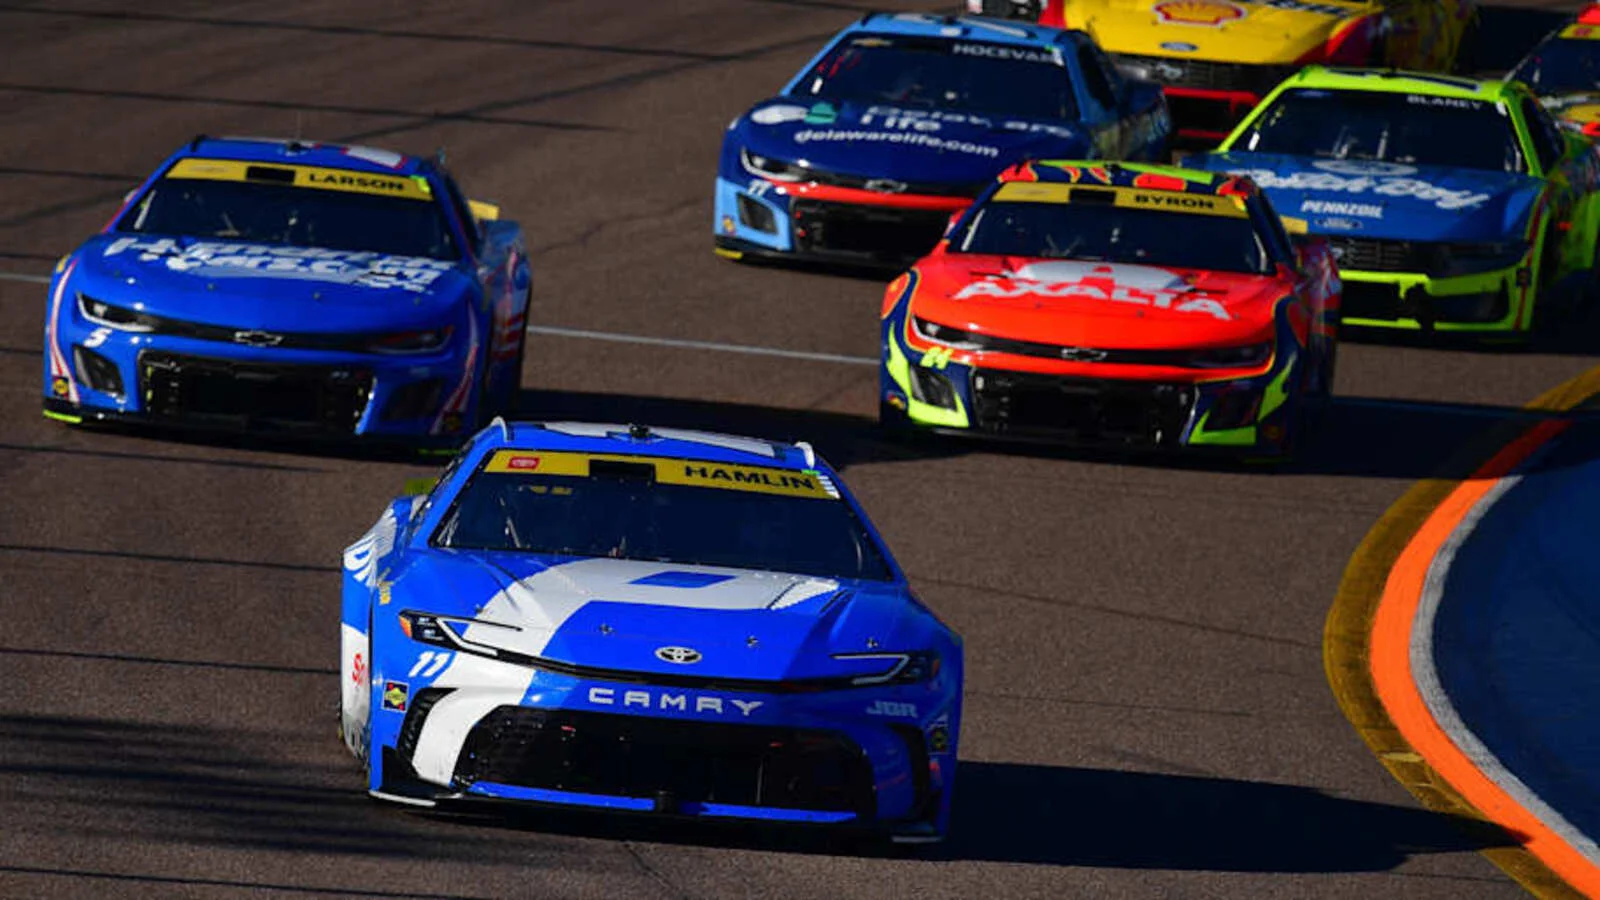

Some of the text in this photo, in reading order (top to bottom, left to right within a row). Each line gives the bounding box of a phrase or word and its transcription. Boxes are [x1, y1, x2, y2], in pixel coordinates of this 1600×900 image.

[794, 127, 999, 158] delawarelife.com
[308, 173, 404, 191] LARSON
[1135, 194, 1214, 209] BYRON
[1301, 199, 1383, 219] PENNZOIL
[954, 279, 1232, 321] AXALTA
[82, 326, 113, 349] 5
[920, 346, 954, 370] 24
[684, 465, 815, 491] HAMLIN
[408, 650, 452, 678] 11
[588, 686, 765, 717] CAMRY
